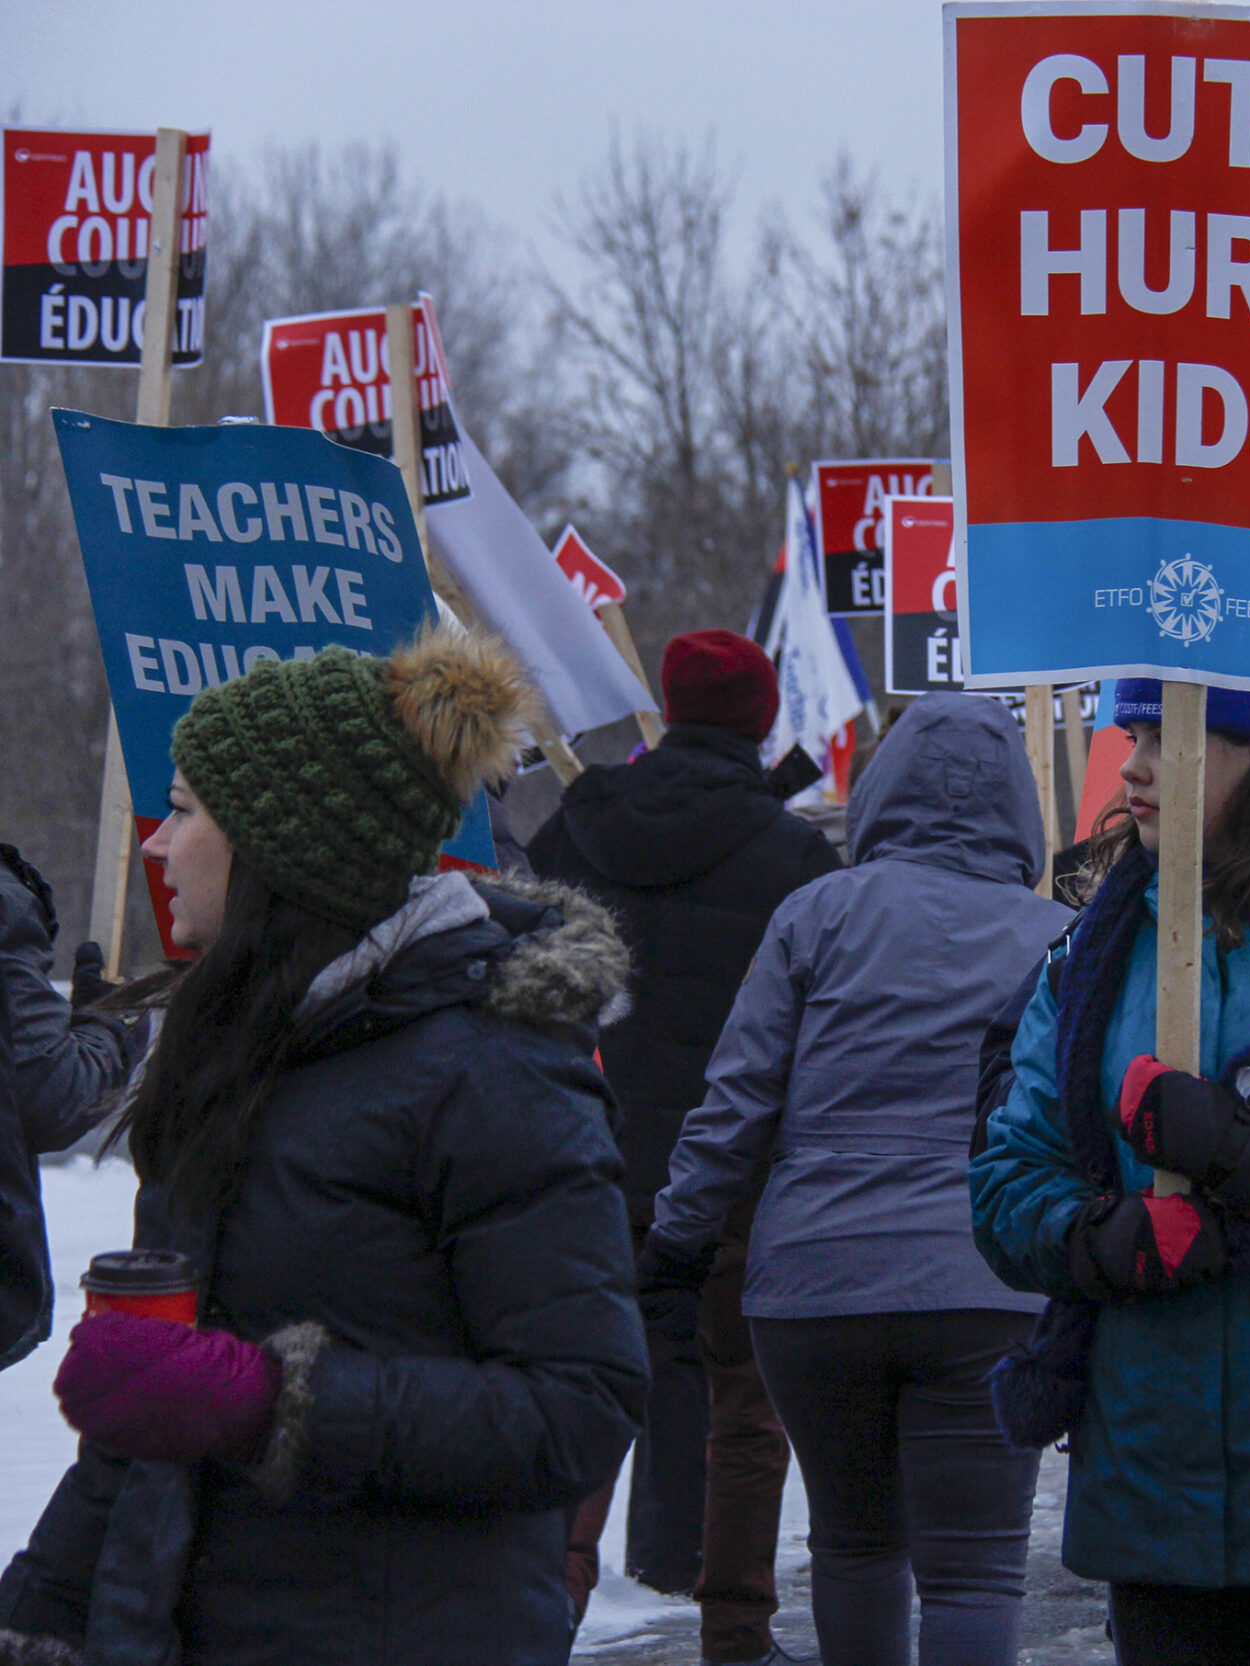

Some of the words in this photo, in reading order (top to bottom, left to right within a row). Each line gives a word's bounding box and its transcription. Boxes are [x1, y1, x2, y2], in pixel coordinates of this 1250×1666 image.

[100, 472, 403, 563] TEACHERS
[184, 563, 373, 630] MAKE
[1094, 587, 1143, 608] ETFO
